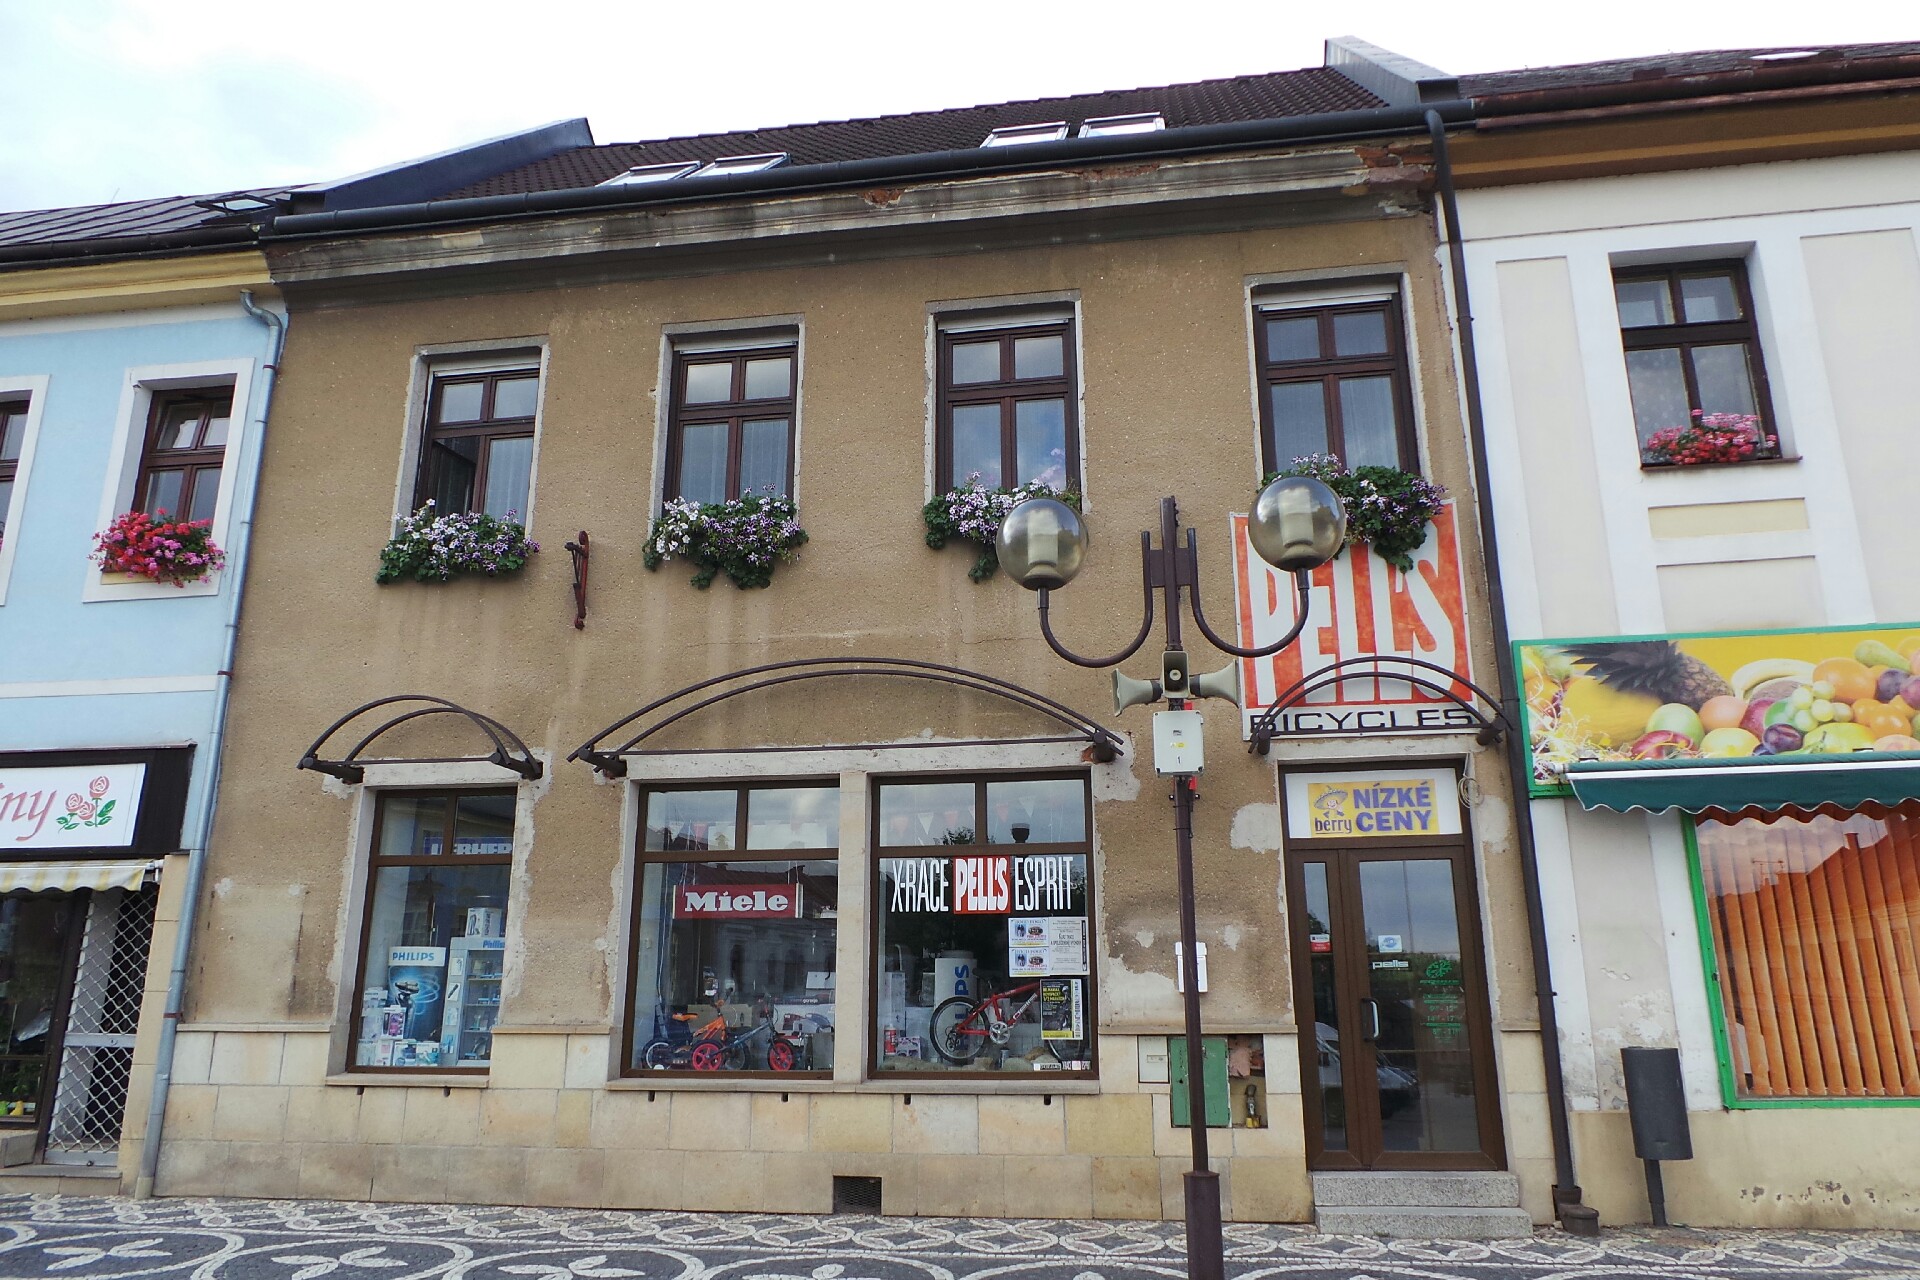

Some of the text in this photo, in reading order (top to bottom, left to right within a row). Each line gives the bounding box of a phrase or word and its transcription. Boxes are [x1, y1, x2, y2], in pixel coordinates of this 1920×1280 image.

[1250, 708, 1474, 733] BICYCLES
[1353, 781, 1431, 809] NÍZKÉ
[0, 783, 57, 841] ny
[1315, 810, 1431, 834] berry CENY
[891, 856, 1074, 912] X-RACE PELL'S ESPRIT
[685, 890, 788, 912] Miele
[392, 952, 434, 961] PHILIPS
